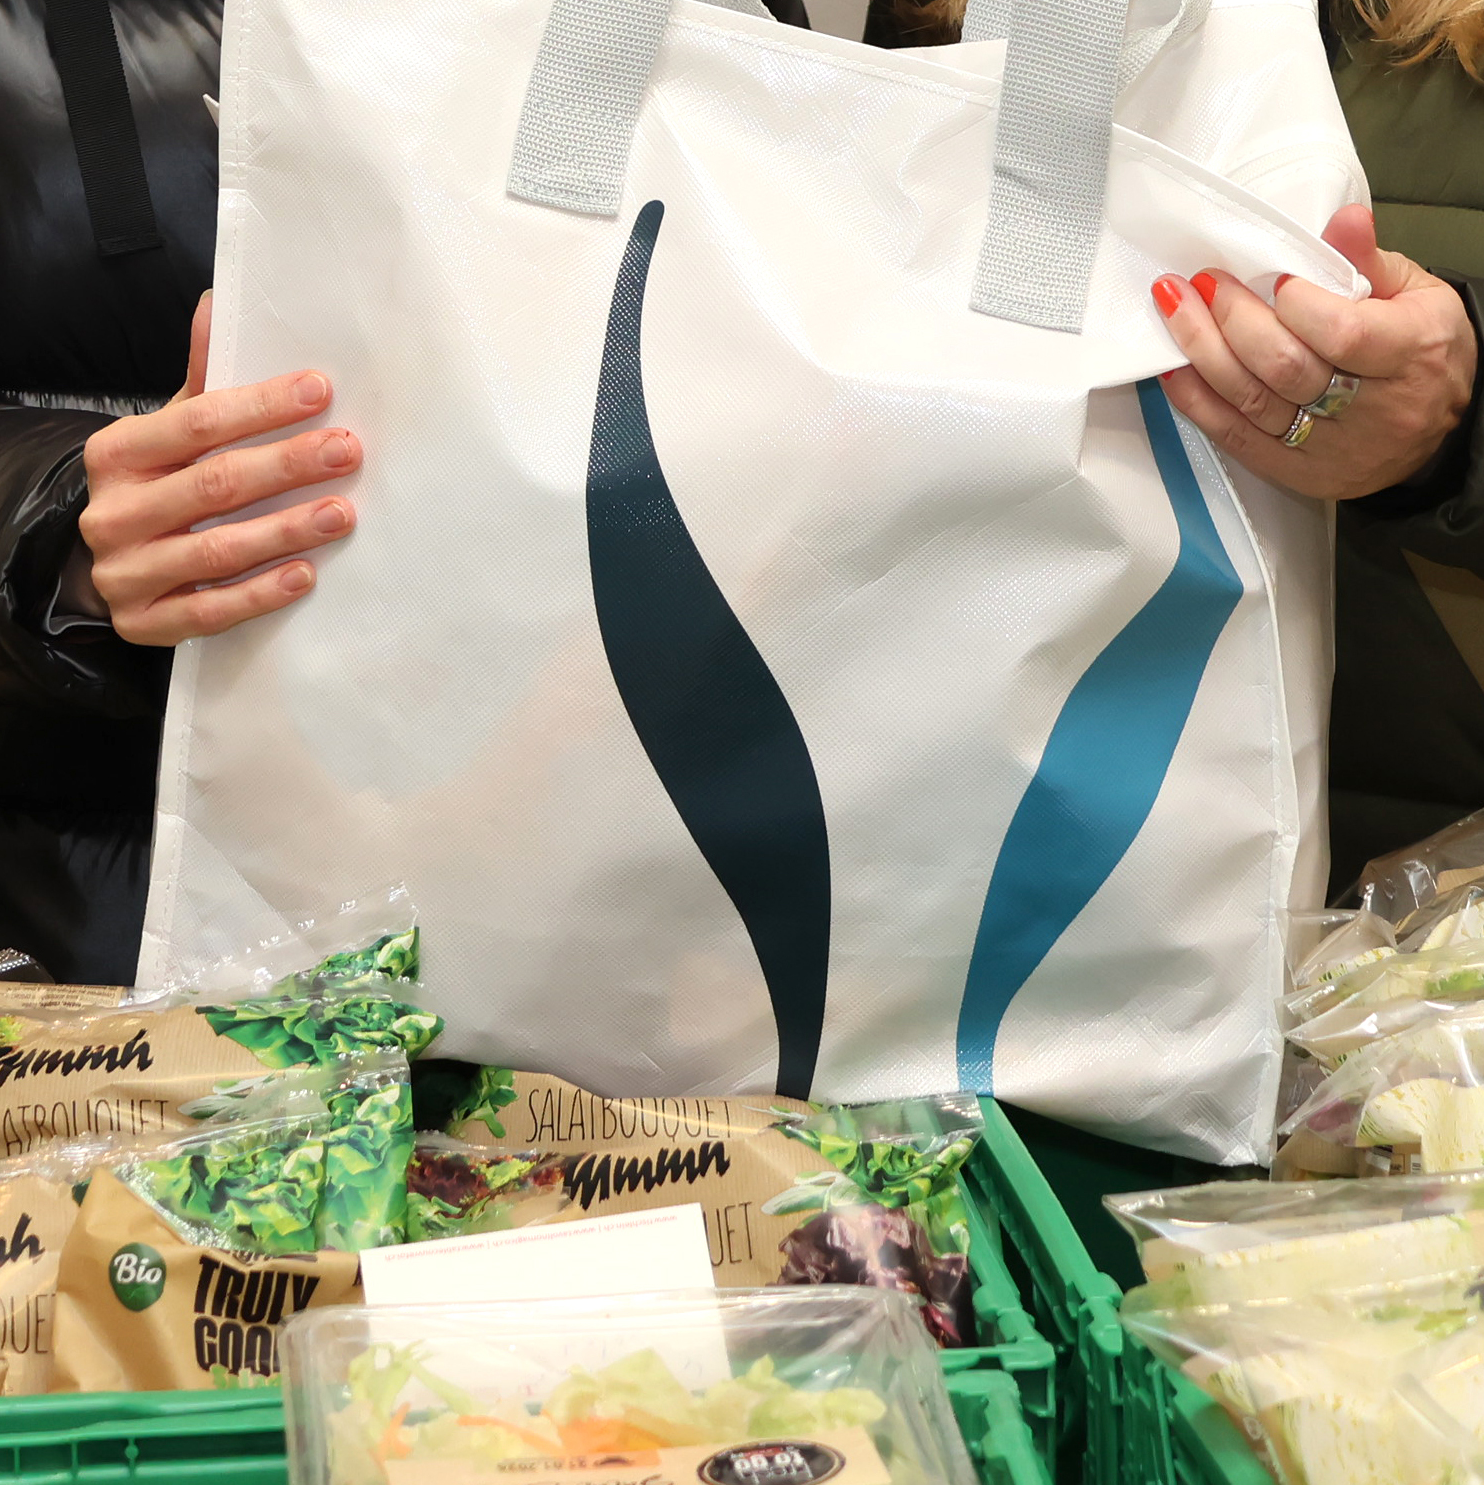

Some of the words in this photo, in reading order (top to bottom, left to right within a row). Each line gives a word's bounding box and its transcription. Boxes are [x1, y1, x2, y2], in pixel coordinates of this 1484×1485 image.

[113, 1253, 163, 1284] Bio
[193, 1254, 321, 1325] TRULY
[193, 1315, 282, 1378] GOO
